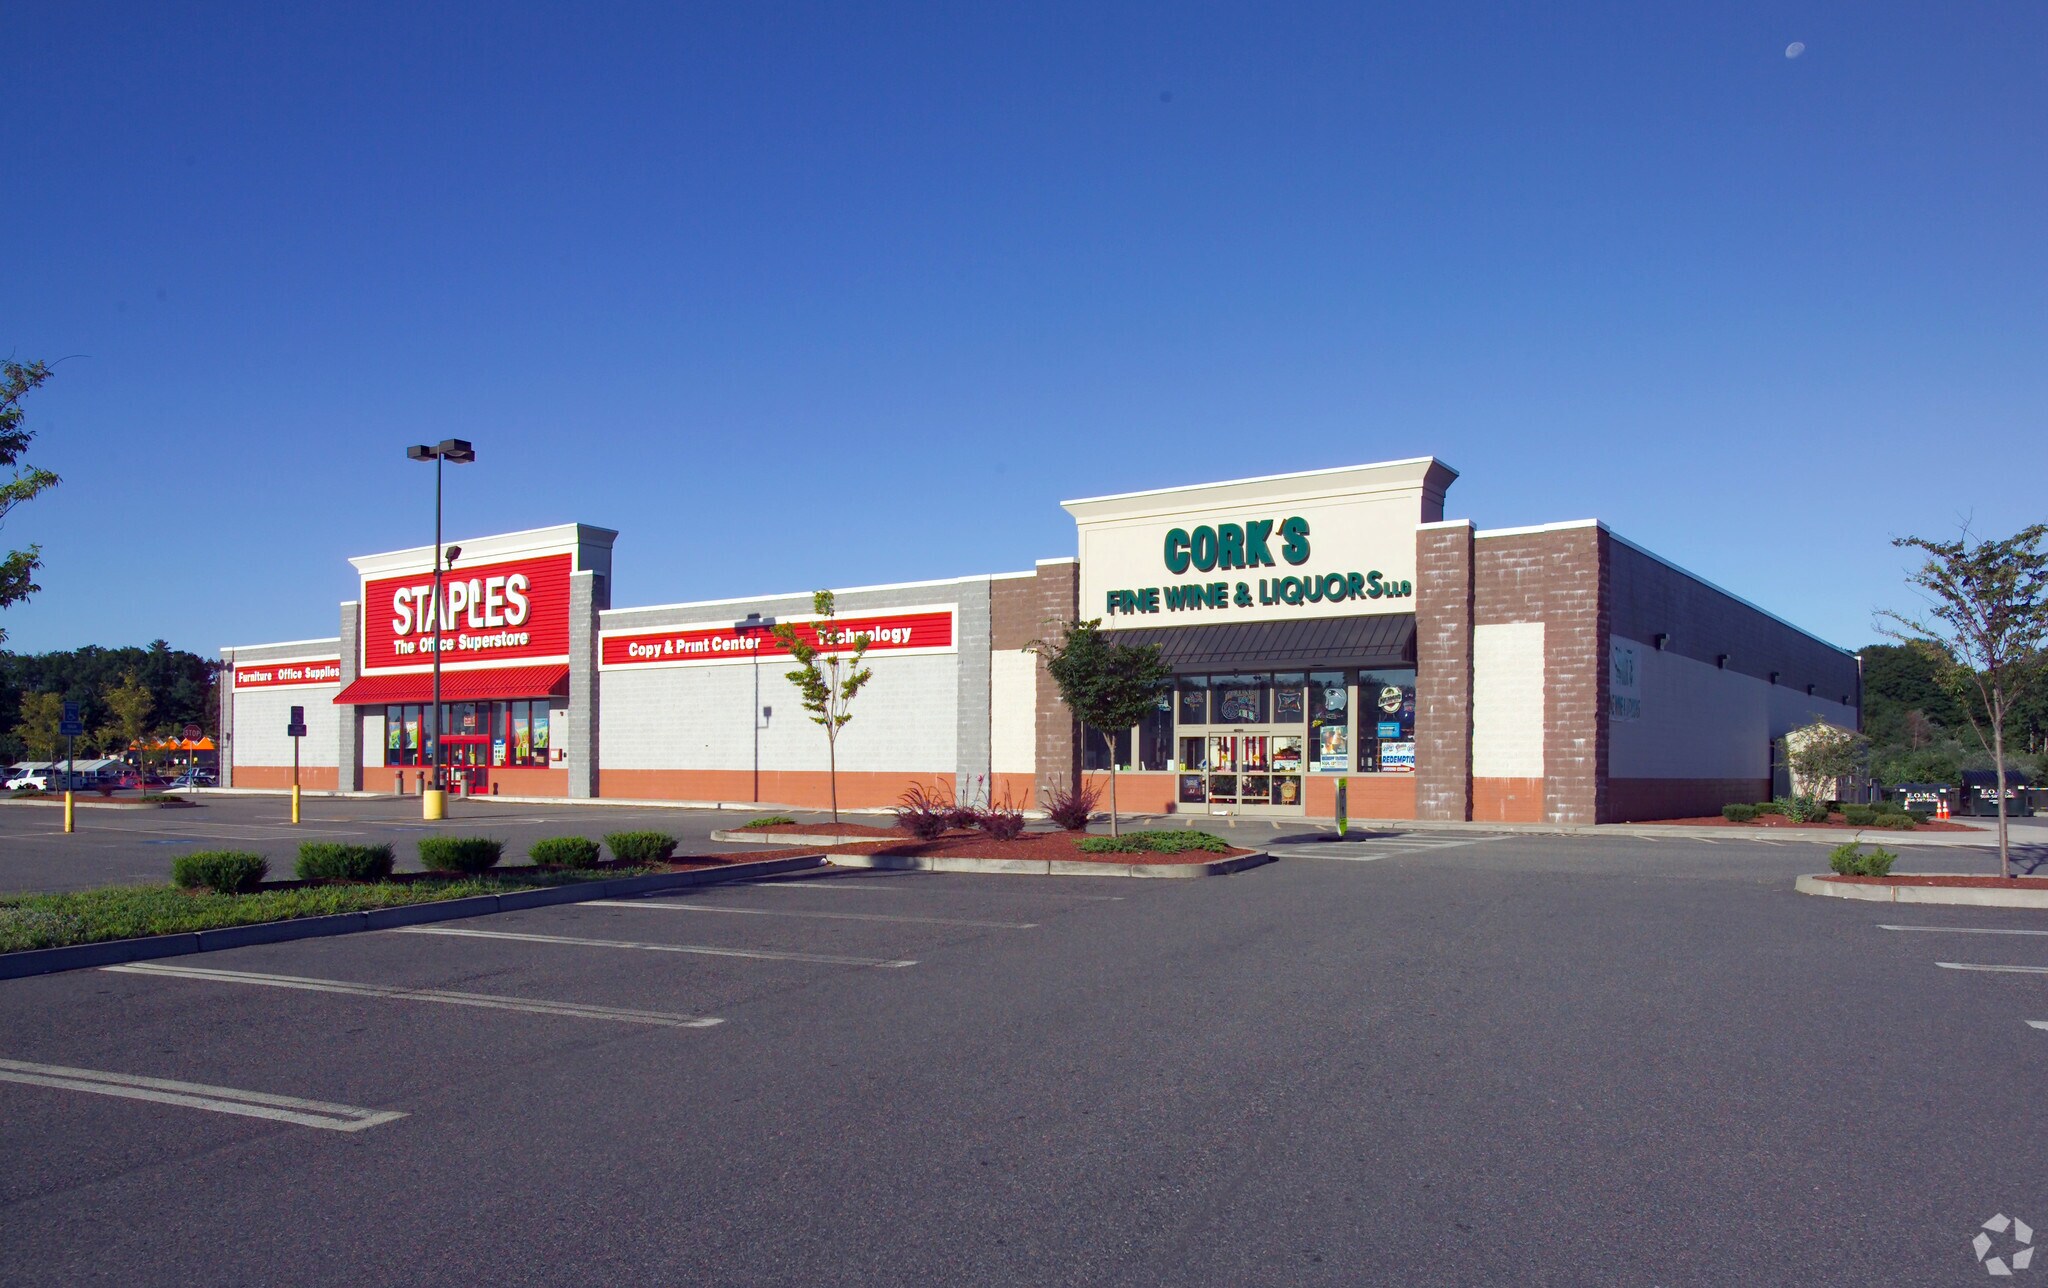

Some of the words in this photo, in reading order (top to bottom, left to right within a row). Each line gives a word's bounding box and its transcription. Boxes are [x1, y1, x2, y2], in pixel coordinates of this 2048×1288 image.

[1164, 516, 1310, 575] CORK'S
[392, 573, 530, 636] STAPLES
[1107, 588, 1160, 616] FINE
[1163, 582, 1229, 612] WINE
[1233, 581, 1254, 608] &
[1259, 570, 1384, 606] LIQUORS
[393, 639, 416, 655] The
[419, 637, 456, 653] Offce
[458, 631, 530, 651] Superstore
[628, 641, 661, 658] Copy
[664, 639, 674, 654] &
[676, 637, 710, 653] Print
[711, 635, 761, 652] Center
[238, 671, 273, 683] Furniture
[278, 668, 302, 680] Office
[305, 665, 340, 680] Supplies
